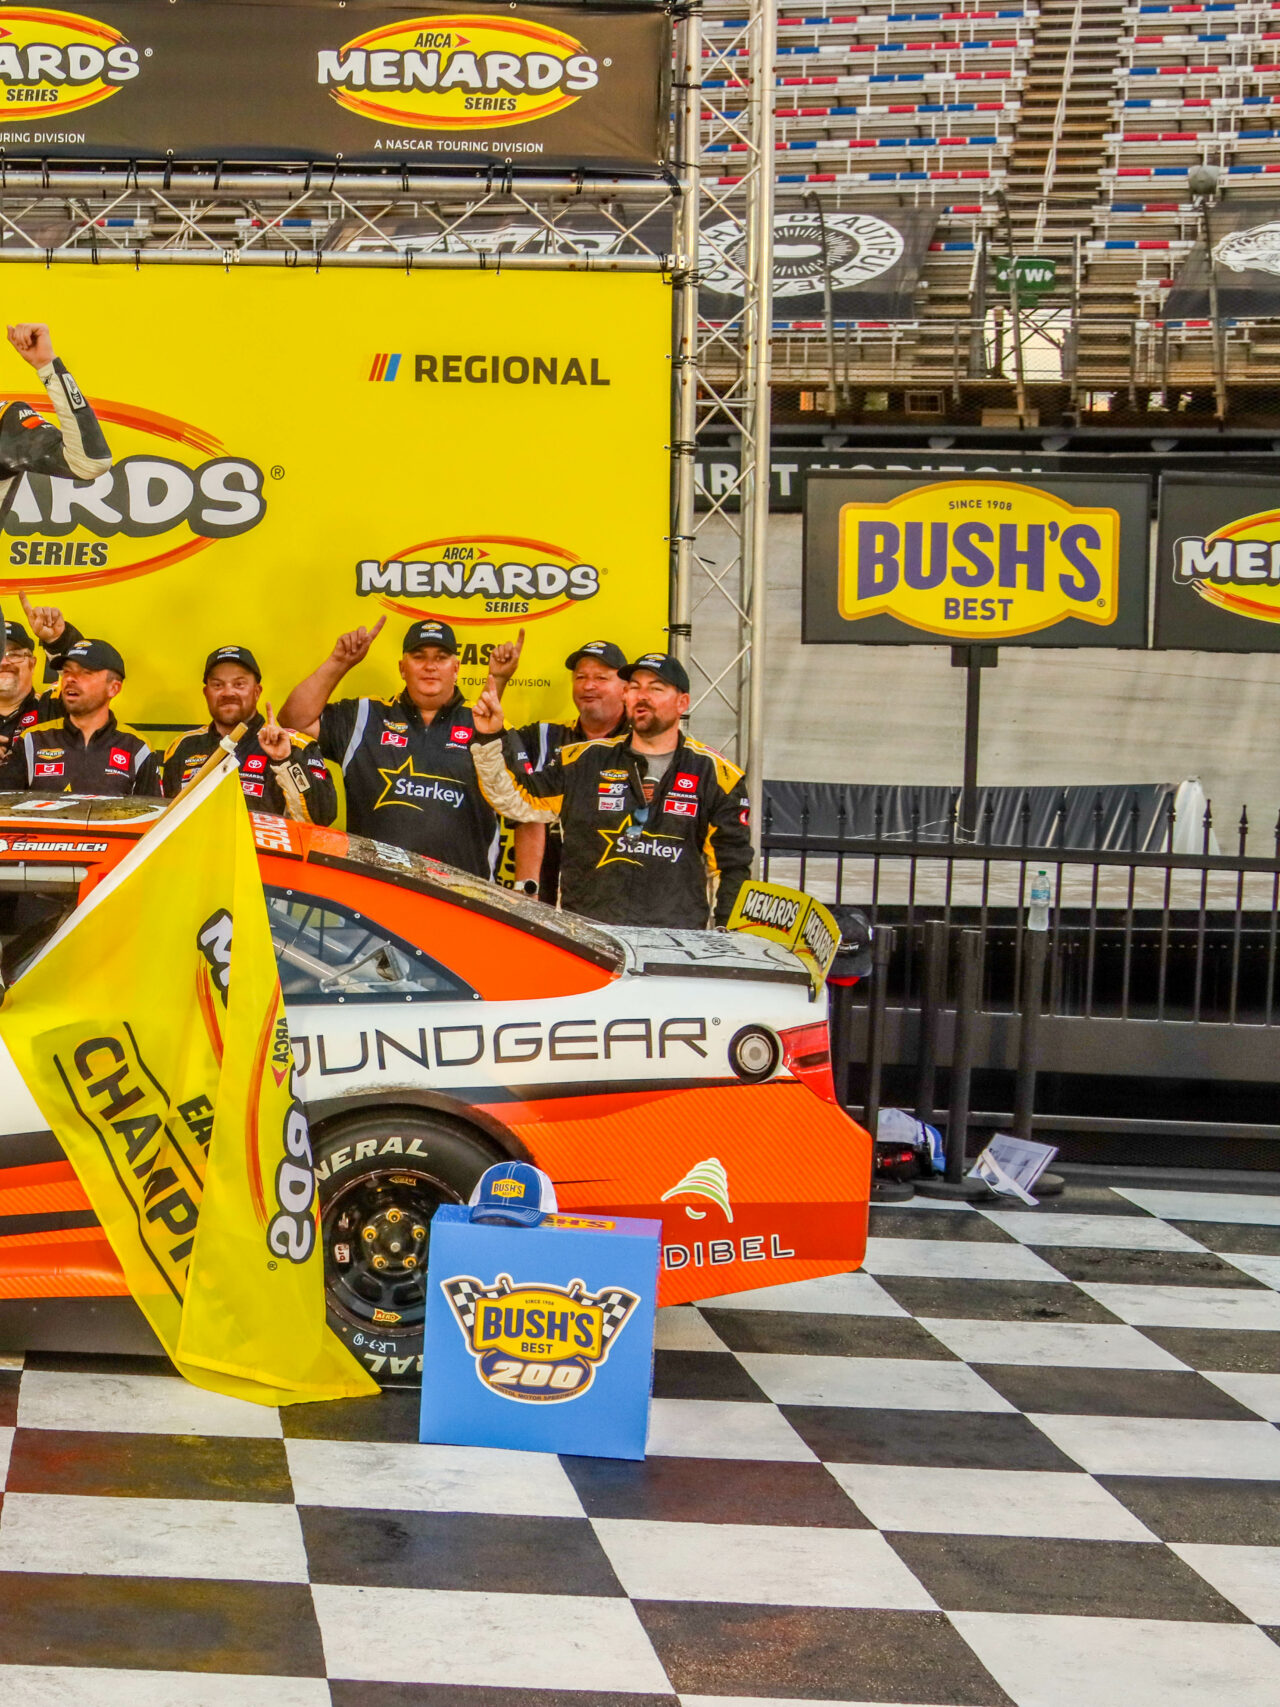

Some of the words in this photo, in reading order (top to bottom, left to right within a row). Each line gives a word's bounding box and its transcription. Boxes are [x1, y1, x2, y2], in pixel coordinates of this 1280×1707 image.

[414, 32, 452, 48] ARCA
[317, 50, 599, 90] MENARDS
[6, 88, 59, 102] SERIES
[464, 97, 517, 111] SERIES
[34, 133, 85, 144] DIVISION
[374, 140, 383, 150] A
[385, 139, 433, 151] NASCAR
[437, 140, 489, 152] TOURING
[492, 141, 544, 153] DIVISION
[414, 354, 611, 387] REGIONAL
[948, 499, 982, 510] SINCE
[986, 499, 1013, 511] 1908
[8, 540, 109, 567] SERIES
[442, 547, 474, 560] ARCA
[857, 519, 1101, 602] BUSH'S
[360, 562, 598, 596] MENARDS
[484, 601, 530, 613] SERIES
[944, 597, 1014, 621] BEST
[508, 678, 551, 688] DIVISION
[394, 778, 465, 808] Starkey
[741, 889, 800, 930] MENARDS
[802, 909, 835, 971] MENARDS
[482, 1306, 595, 1348] BUSH'S
[521, 1342, 554, 1354] BEST
[489, 1360, 584, 1390] 200
